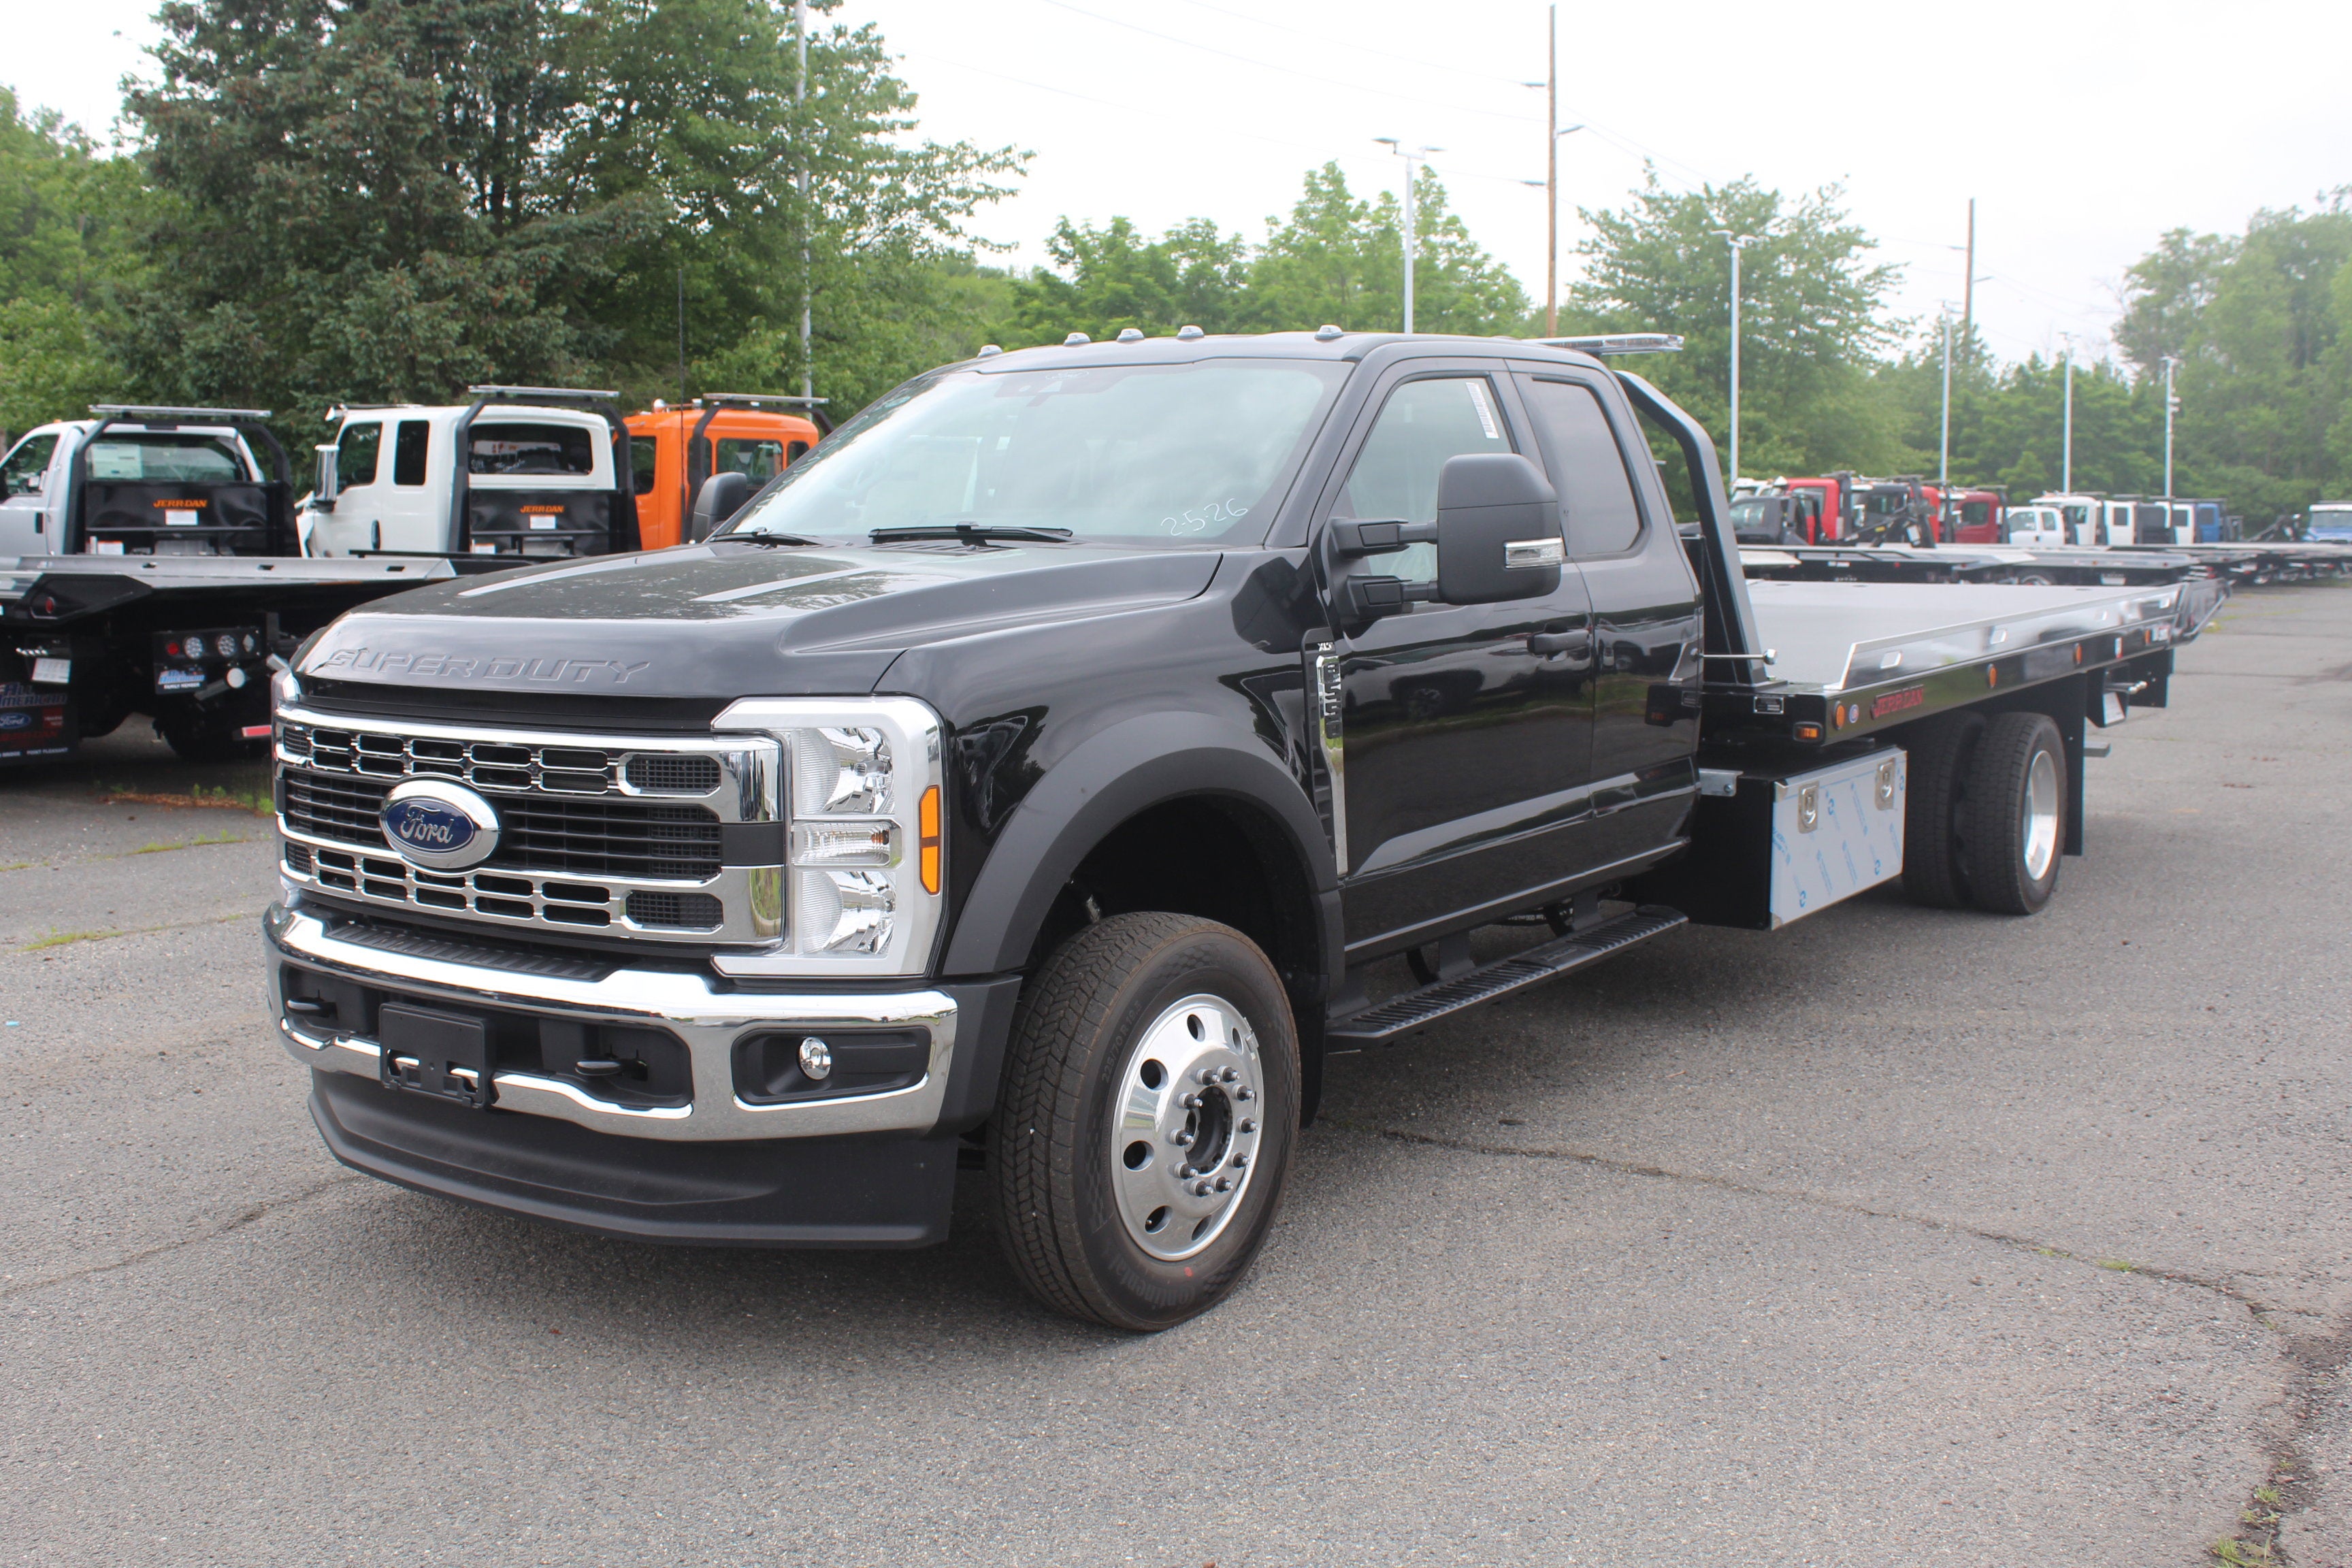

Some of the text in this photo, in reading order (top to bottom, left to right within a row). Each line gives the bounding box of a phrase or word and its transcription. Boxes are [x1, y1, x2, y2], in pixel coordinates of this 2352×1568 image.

[153, 500, 208, 508] JERR-DAN
[1160, 498, 1248, 536] 2-5-26
[327, 647, 650, 683] SUPER DUTY
[0, 693, 67, 708] MERICAN
[400, 804, 454, 844] Ford
